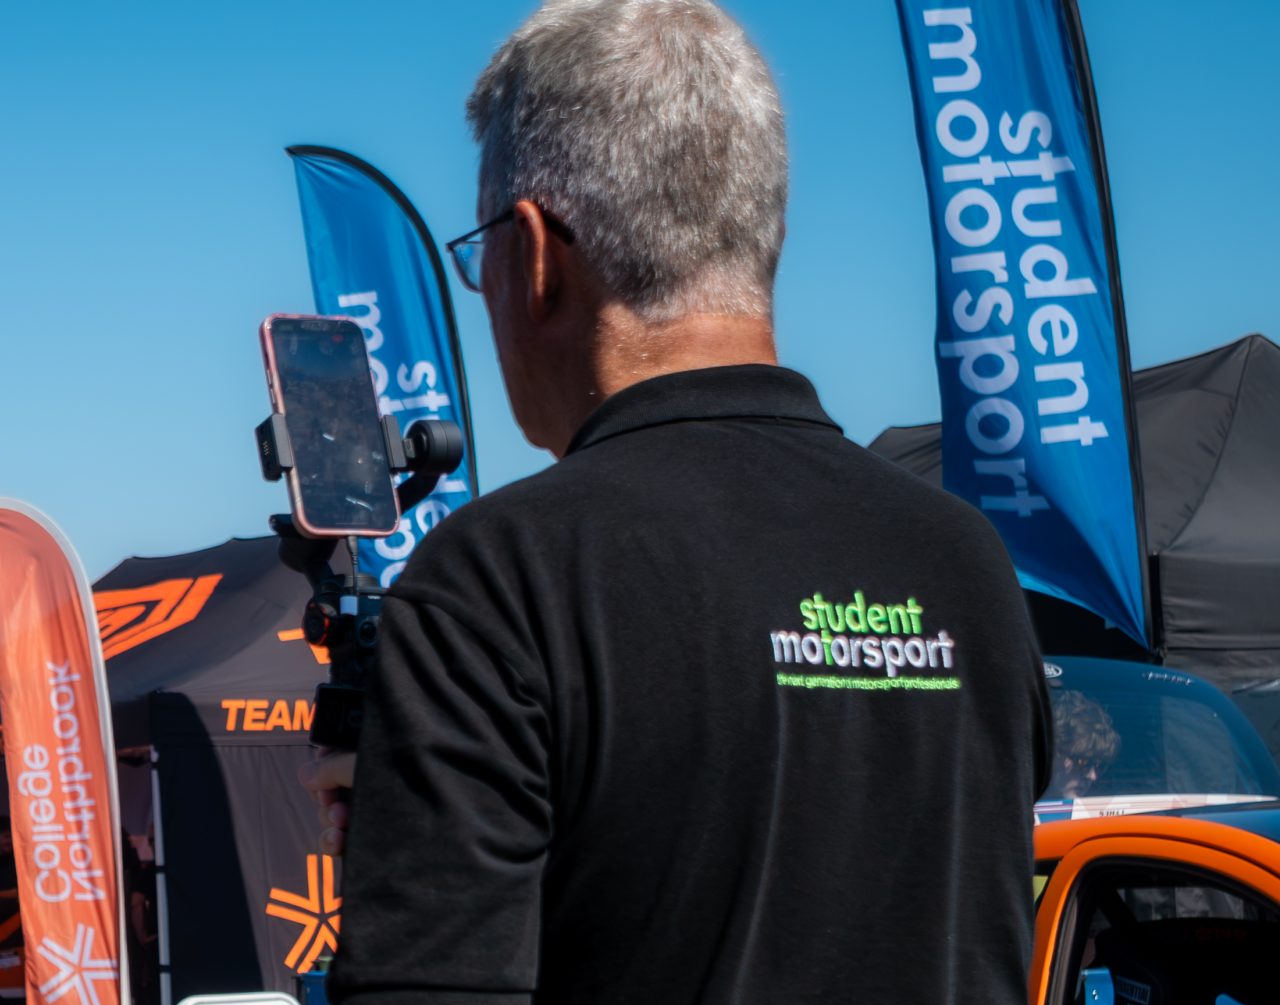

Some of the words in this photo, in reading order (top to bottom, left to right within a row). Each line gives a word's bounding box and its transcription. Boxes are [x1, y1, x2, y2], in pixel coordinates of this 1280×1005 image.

[923, 6, 1051, 518] motorsport
[999, 109, 1109, 447] student
[799, 589, 923, 635] student
[770, 629, 955, 677] motorsport
[221, 699, 316, 731] TEAM
